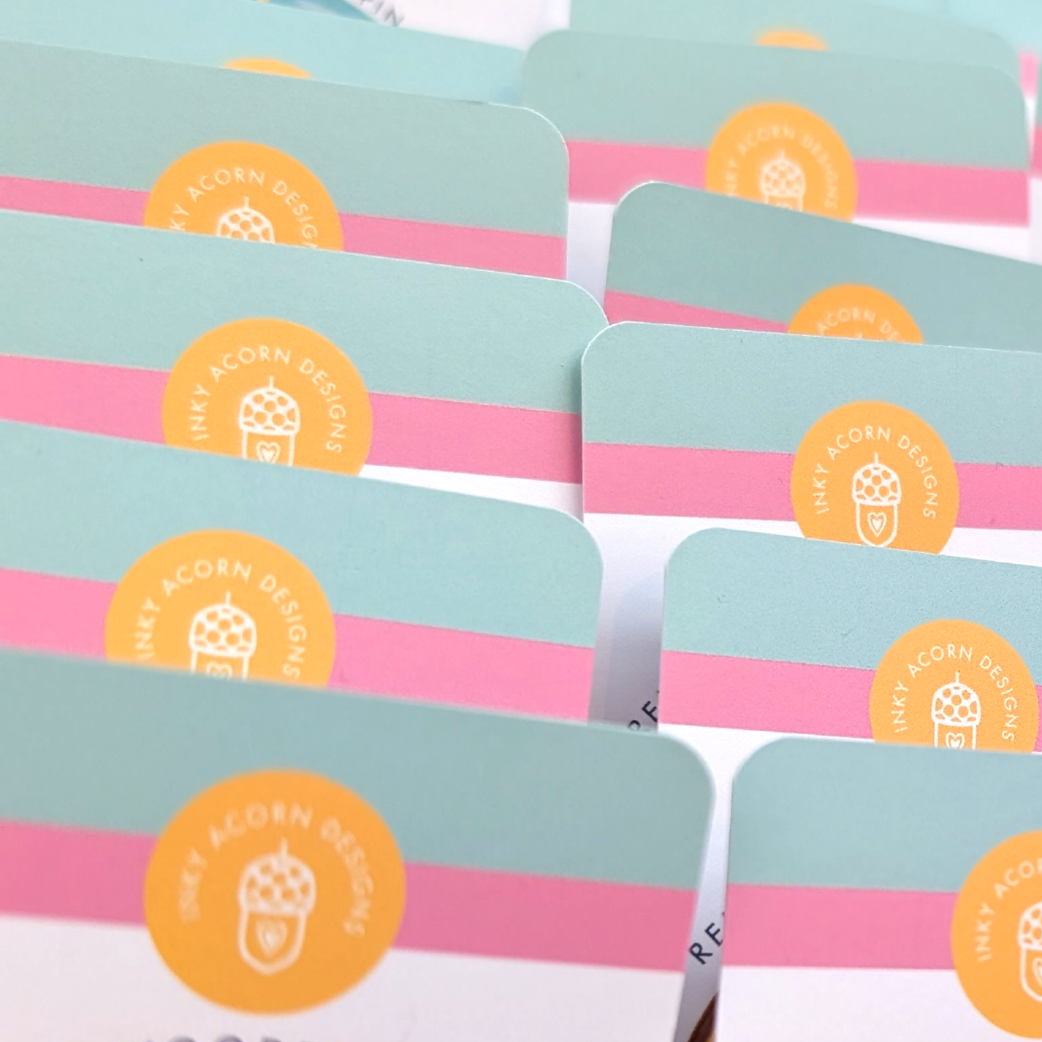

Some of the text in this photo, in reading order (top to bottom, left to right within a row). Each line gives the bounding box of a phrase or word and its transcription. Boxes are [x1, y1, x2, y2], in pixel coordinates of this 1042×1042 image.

[187, 167, 265, 203] ACORN
[272, 180, 318, 248] DESIG
[189, 345, 347, 454] INKY ACORN DESIGNS
[812, 425, 938, 519] INKY ACORN DESIGNS
[135, 557, 307, 679] INKY ACORN DESIGNS
[891, 644, 1018, 742] INKY ACORN DESIGNS
[208, 800, 313, 850] ACORN
[319, 816, 374, 937] DESIGNS
[975, 902, 995, 963] INKY
